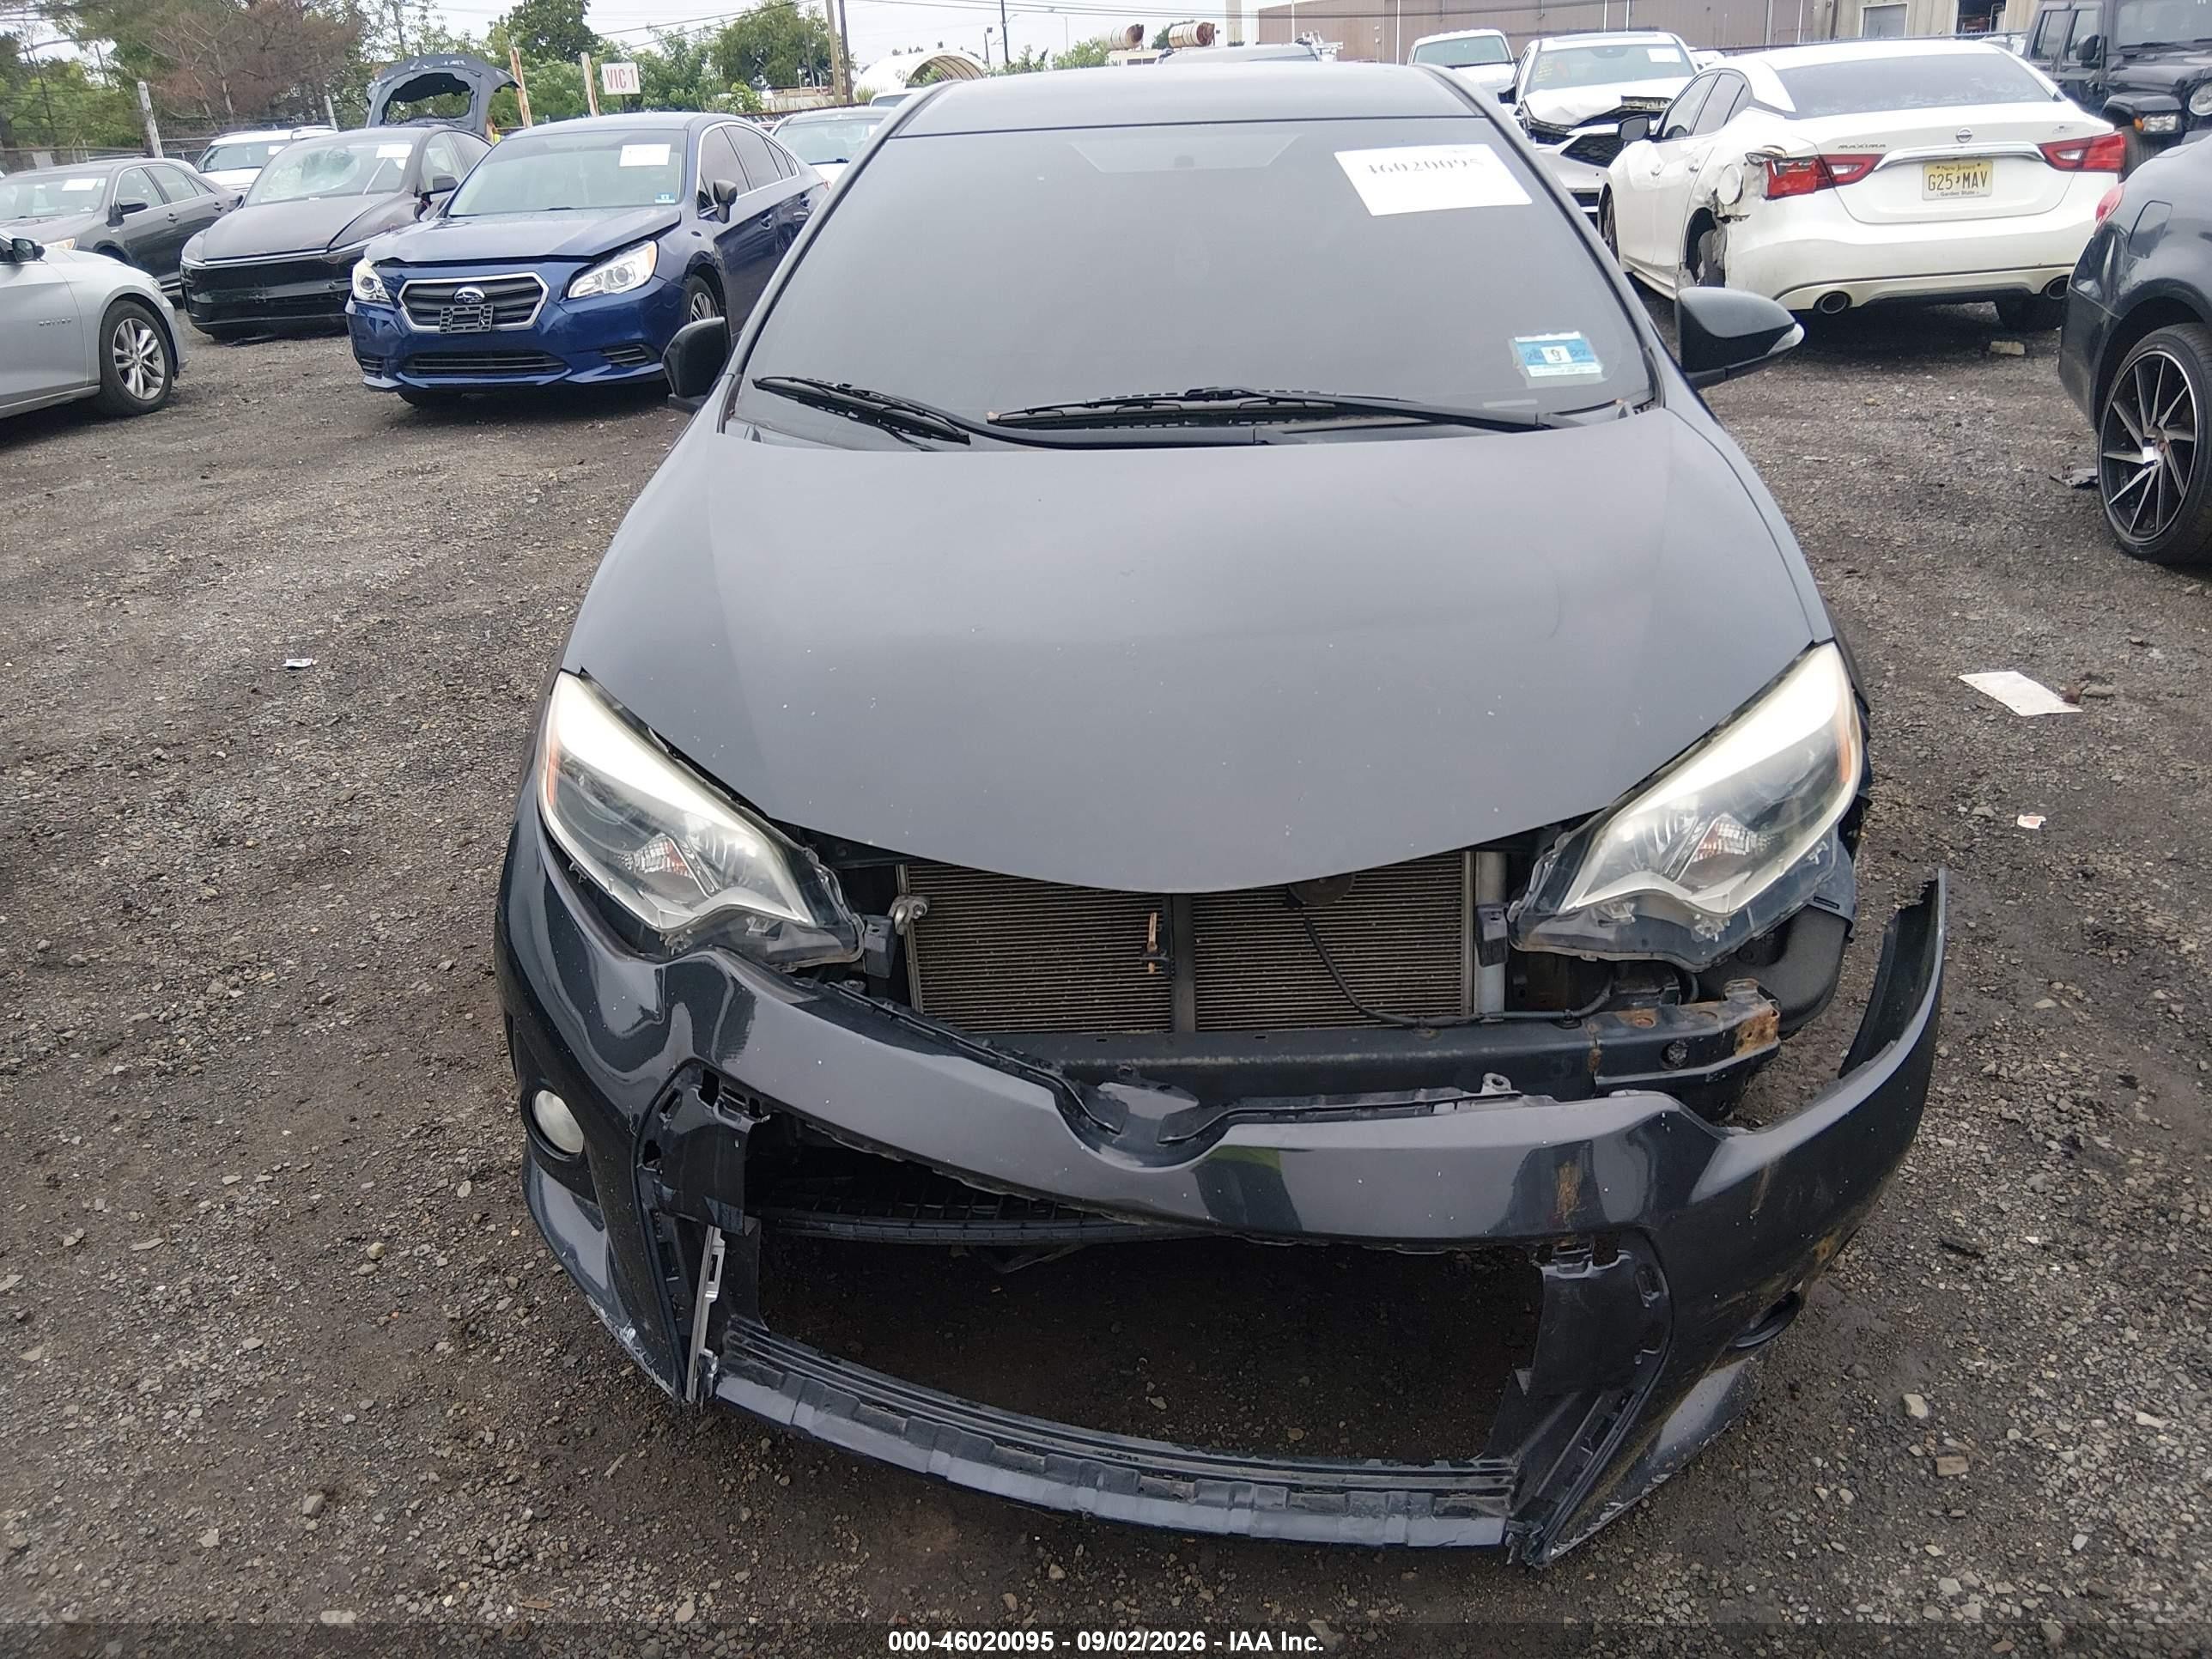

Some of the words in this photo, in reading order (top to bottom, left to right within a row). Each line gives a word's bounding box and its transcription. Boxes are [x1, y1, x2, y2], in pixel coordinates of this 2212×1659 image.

[605, 69, 627, 89] VIC
[629, 69, 635, 88] 1
[1928, 173, 1954, 191] G25
[1962, 171, 1988, 189] MAV
